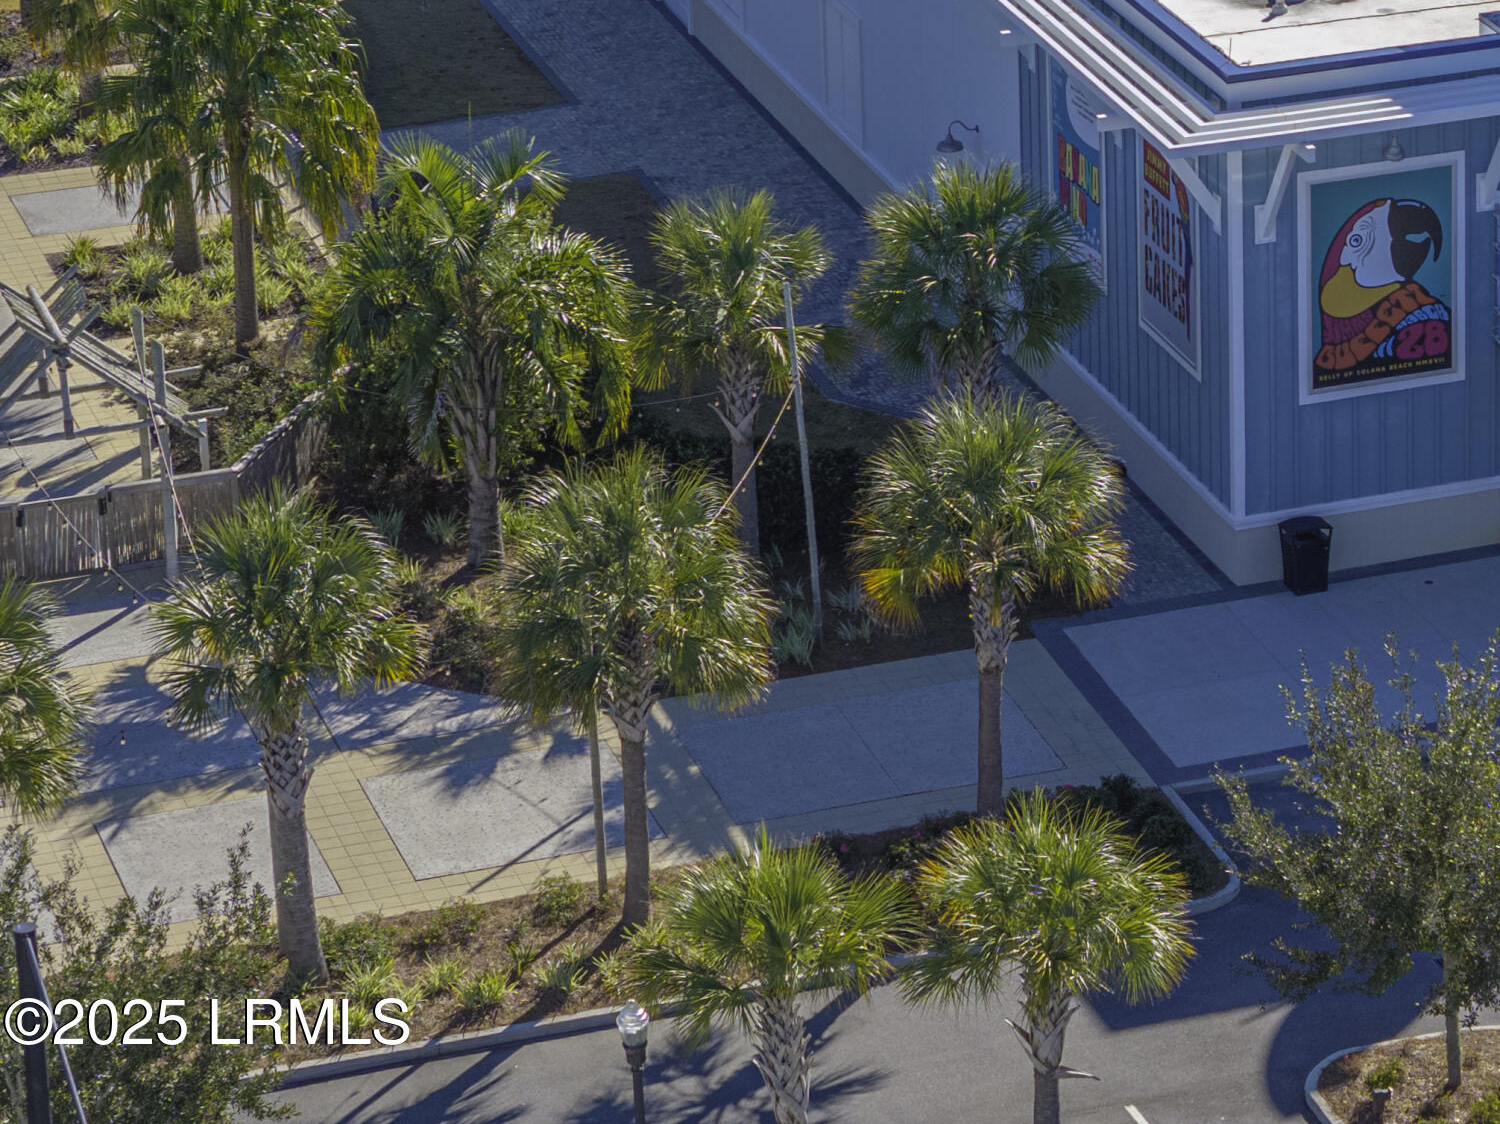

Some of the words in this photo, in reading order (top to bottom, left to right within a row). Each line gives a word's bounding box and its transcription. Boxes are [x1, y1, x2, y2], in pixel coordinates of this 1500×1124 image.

[1144, 187, 1184, 267] FRUIT
[1144, 242, 1186, 325] CAKES
[1343, 370, 1354, 378] UP
[1356, 366, 1386, 376] SOLANA
[1388, 361, 1413, 371] BEACH
[1396, 320, 1448, 360] 28
